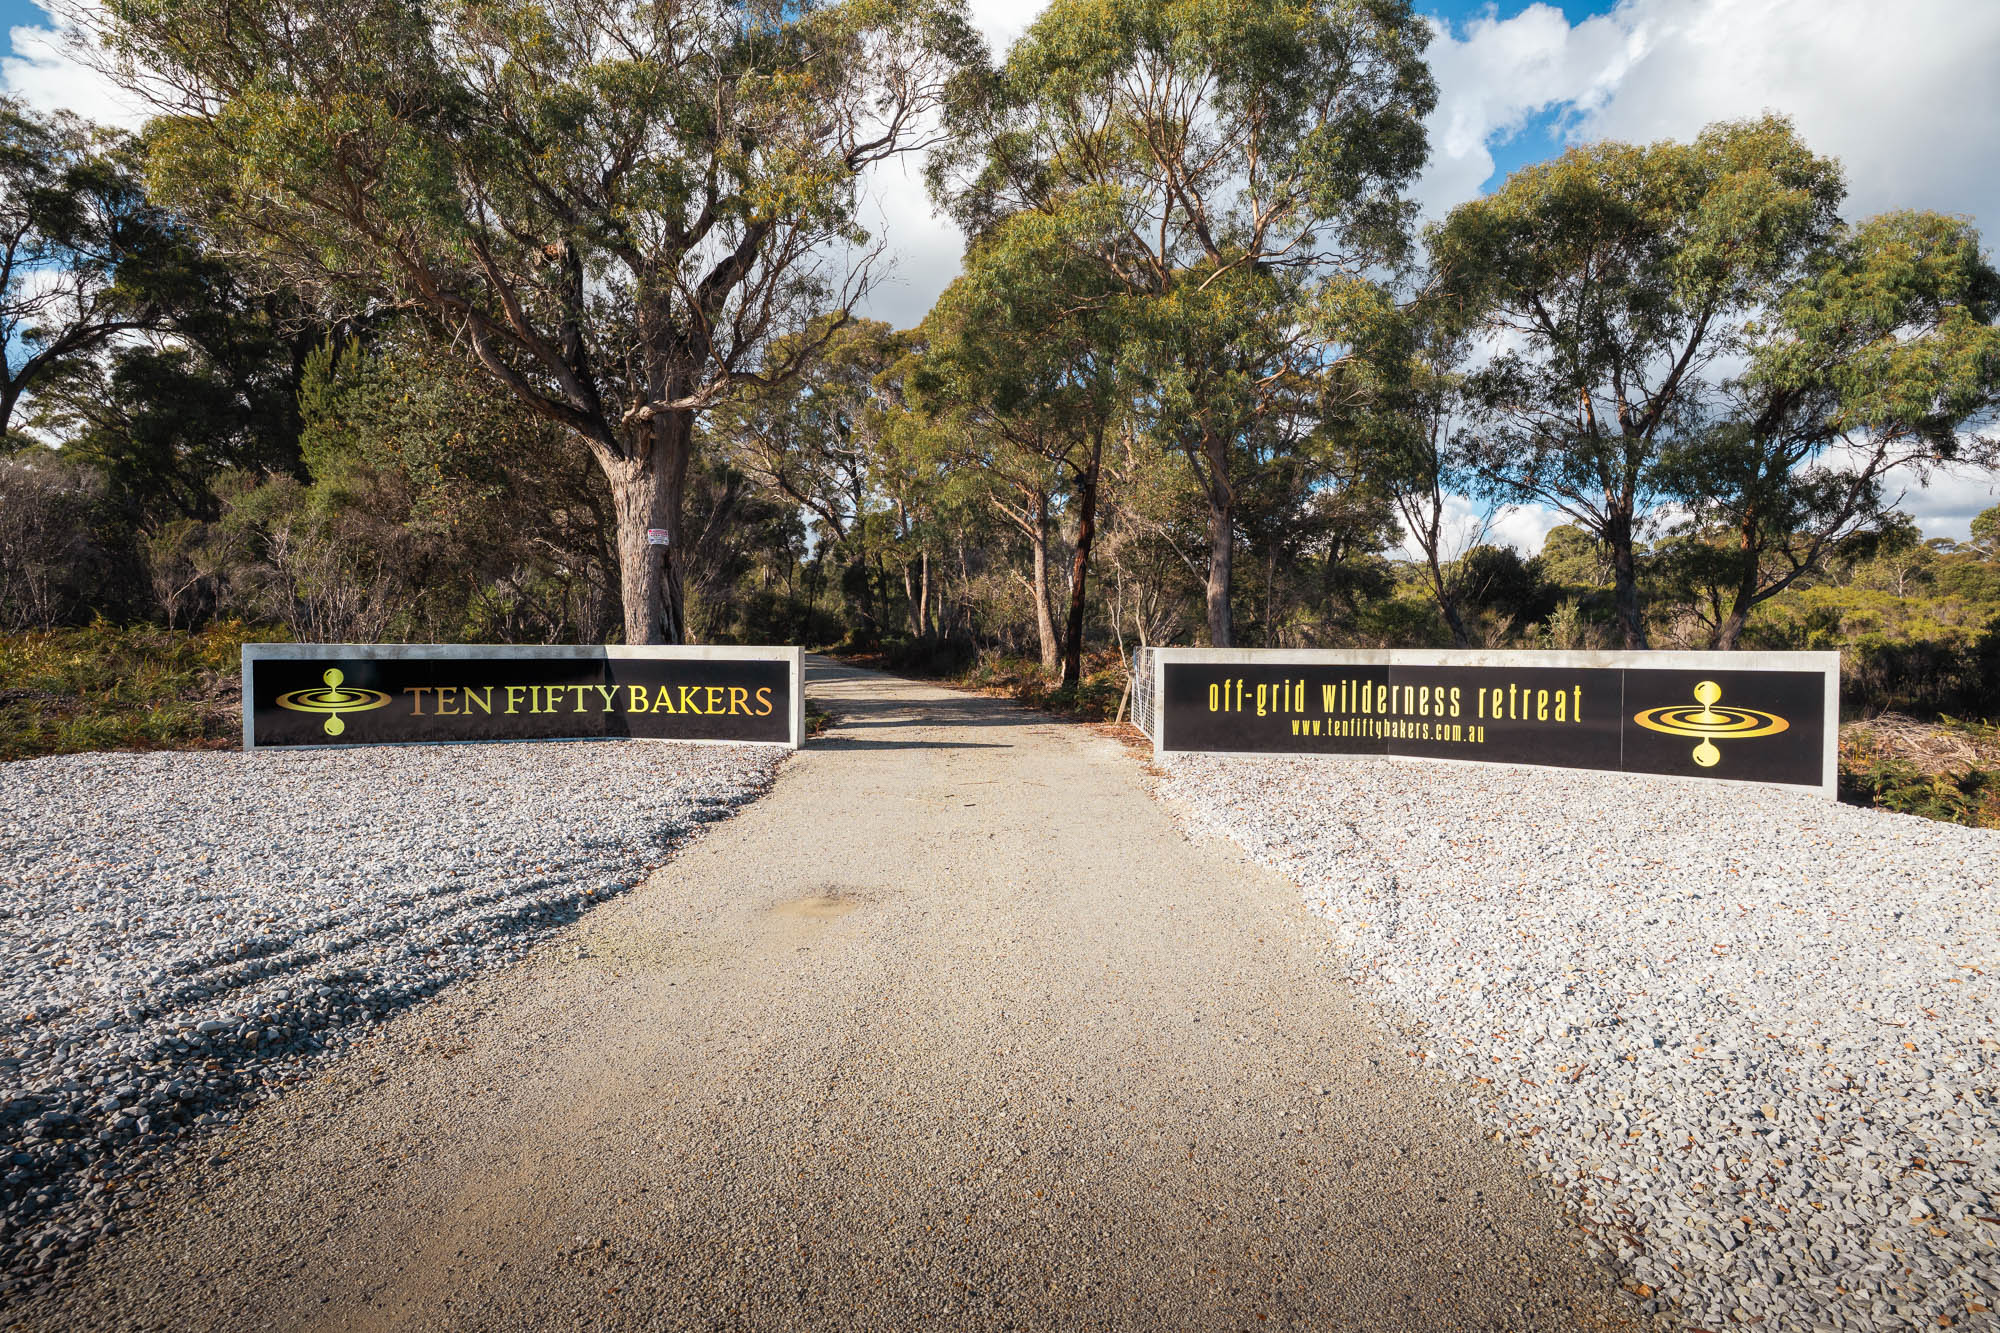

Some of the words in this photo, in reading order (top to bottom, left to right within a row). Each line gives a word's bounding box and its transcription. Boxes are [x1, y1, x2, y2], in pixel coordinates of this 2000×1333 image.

[403, 686, 495, 716] TEN
[504, 684, 621, 714] FIFTY
[627, 684, 774, 716] BAKERS
[1208, 678, 1306, 716] off-grid
[1322, 679, 1461, 718] wilderness
[1478, 685, 1583, 723] retreat
[1291, 717, 1485, 744] www.tenfiftybakers.com.au
